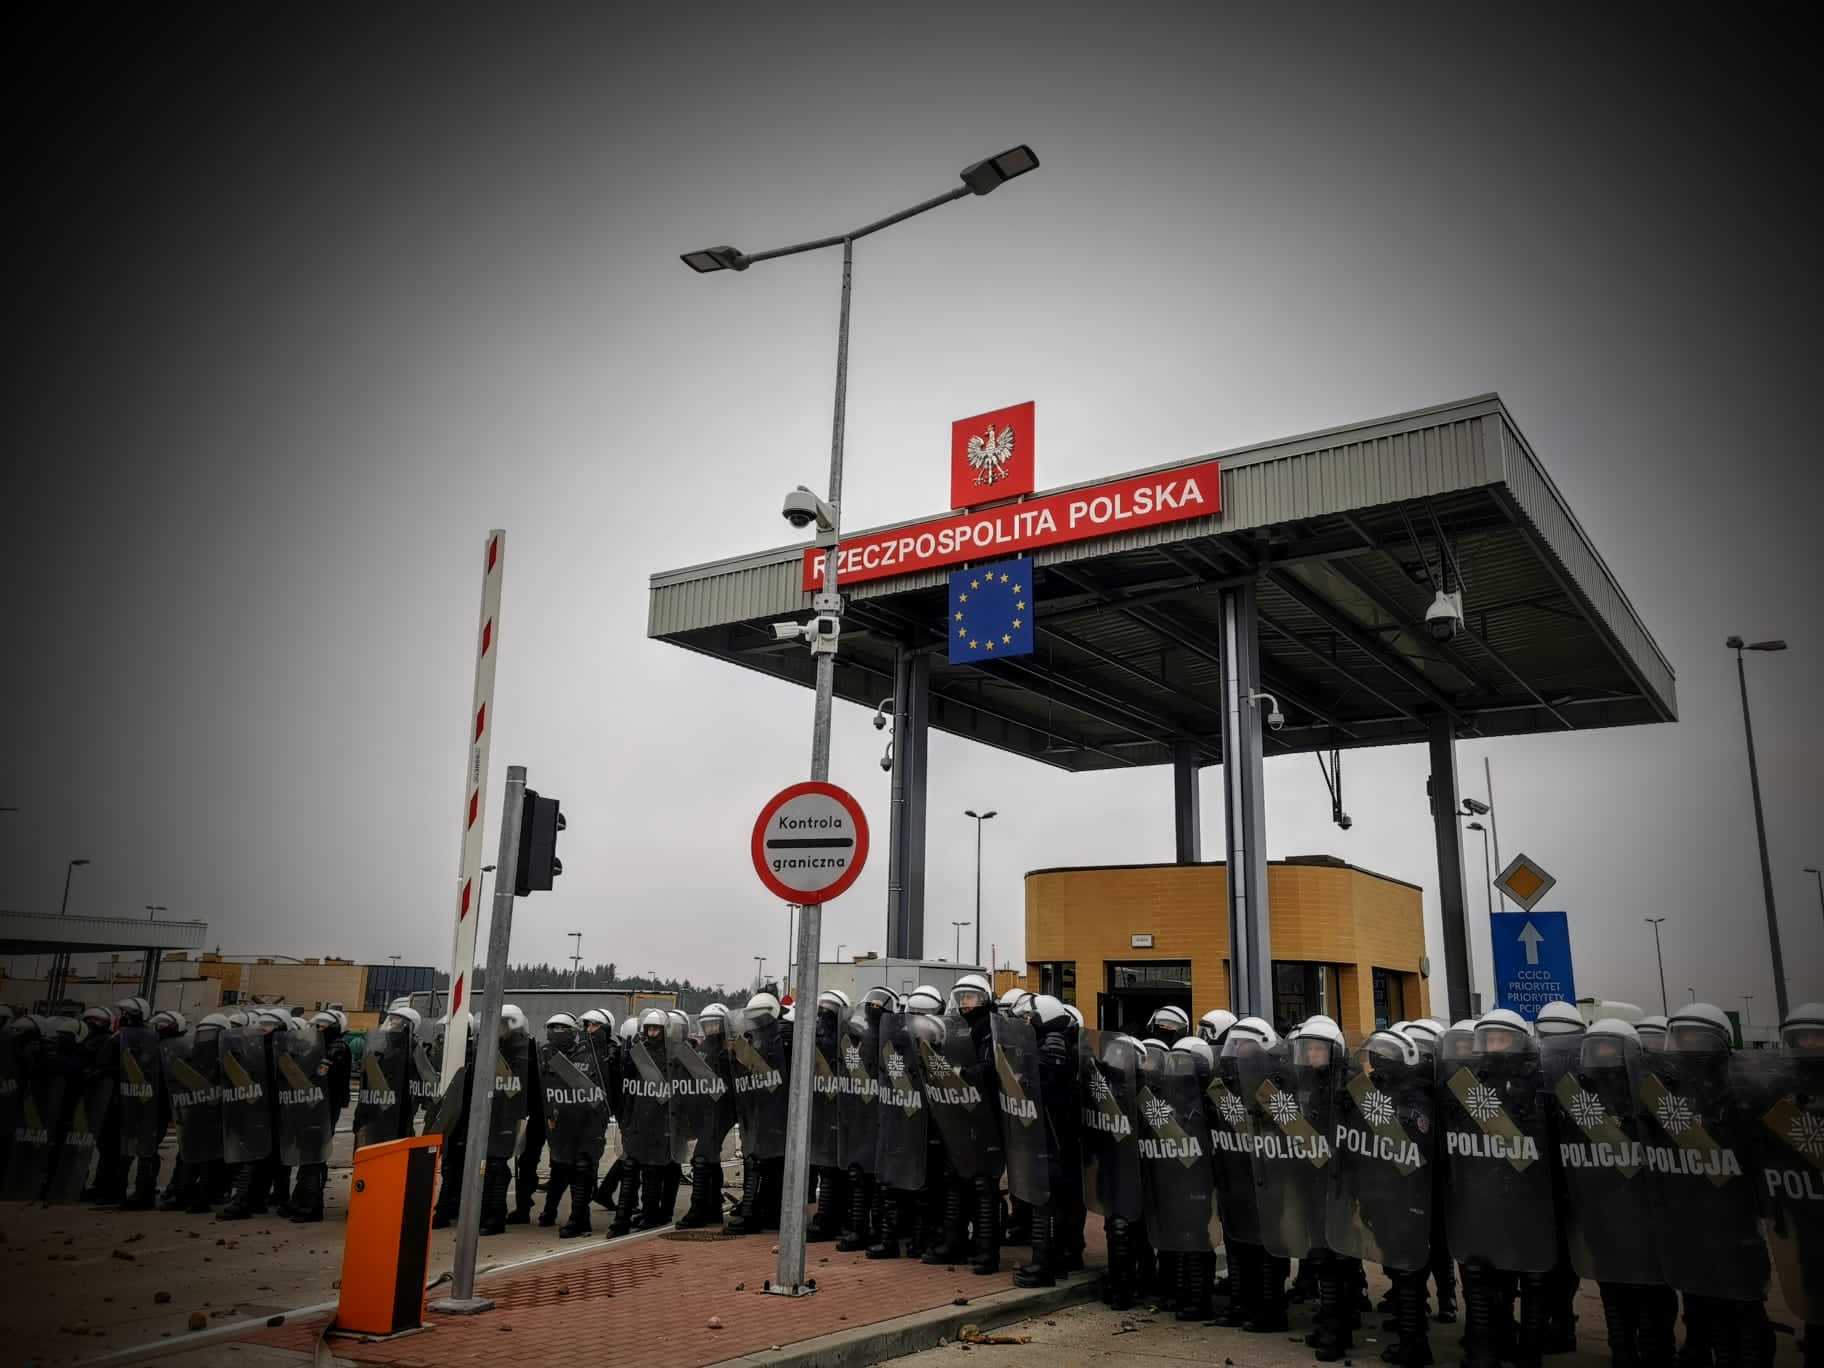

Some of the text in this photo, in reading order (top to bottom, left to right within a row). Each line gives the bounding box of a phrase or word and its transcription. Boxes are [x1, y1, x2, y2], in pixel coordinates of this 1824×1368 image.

[813, 478, 1204, 579] RZECZPOSPOLITA POLSKA
[779, 816, 842, 829] Kontrola
[772, 856, 845, 872] graniczna
[622, 1078, 672, 1099] POLICJA
[673, 1078, 727, 1096] POLICJA
[735, 1070, 783, 1093] POLICJA
[814, 1076, 839, 1093] ICJA
[279, 1086, 324, 1105] POLICJA
[547, 1086, 605, 1104] POLICJA
[879, 1086, 922, 1109] POLICJA
[926, 1085, 981, 1105] POLICJA
[1138, 1136, 1203, 1159] POLICJA
[1210, 1129, 1255, 1153] POLIC
[1254, 1134, 1332, 1160] POLICJA
[1335, 1123, 1421, 1168] POLICJA
[1446, 1131, 1540, 1161] POLICJA
[1559, 1141, 1647, 1167] POLICJA
[1646, 1145, 1742, 1176] POLICJA
